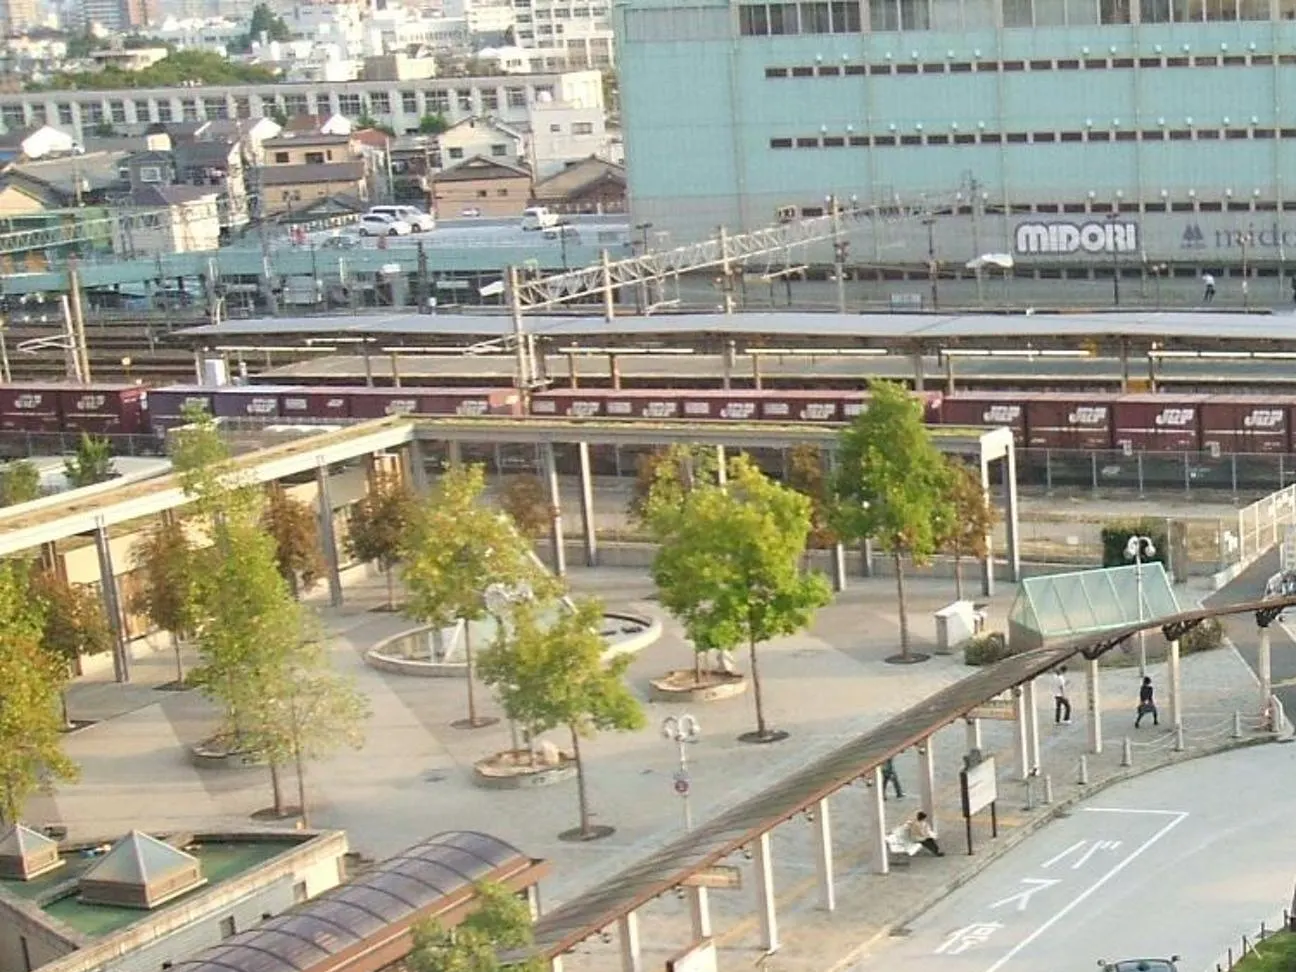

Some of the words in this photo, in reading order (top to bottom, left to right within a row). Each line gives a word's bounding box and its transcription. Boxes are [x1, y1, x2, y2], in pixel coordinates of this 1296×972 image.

[1016, 221, 1139, 253] MIDORI
[934, 840, 1123, 954] バス停
